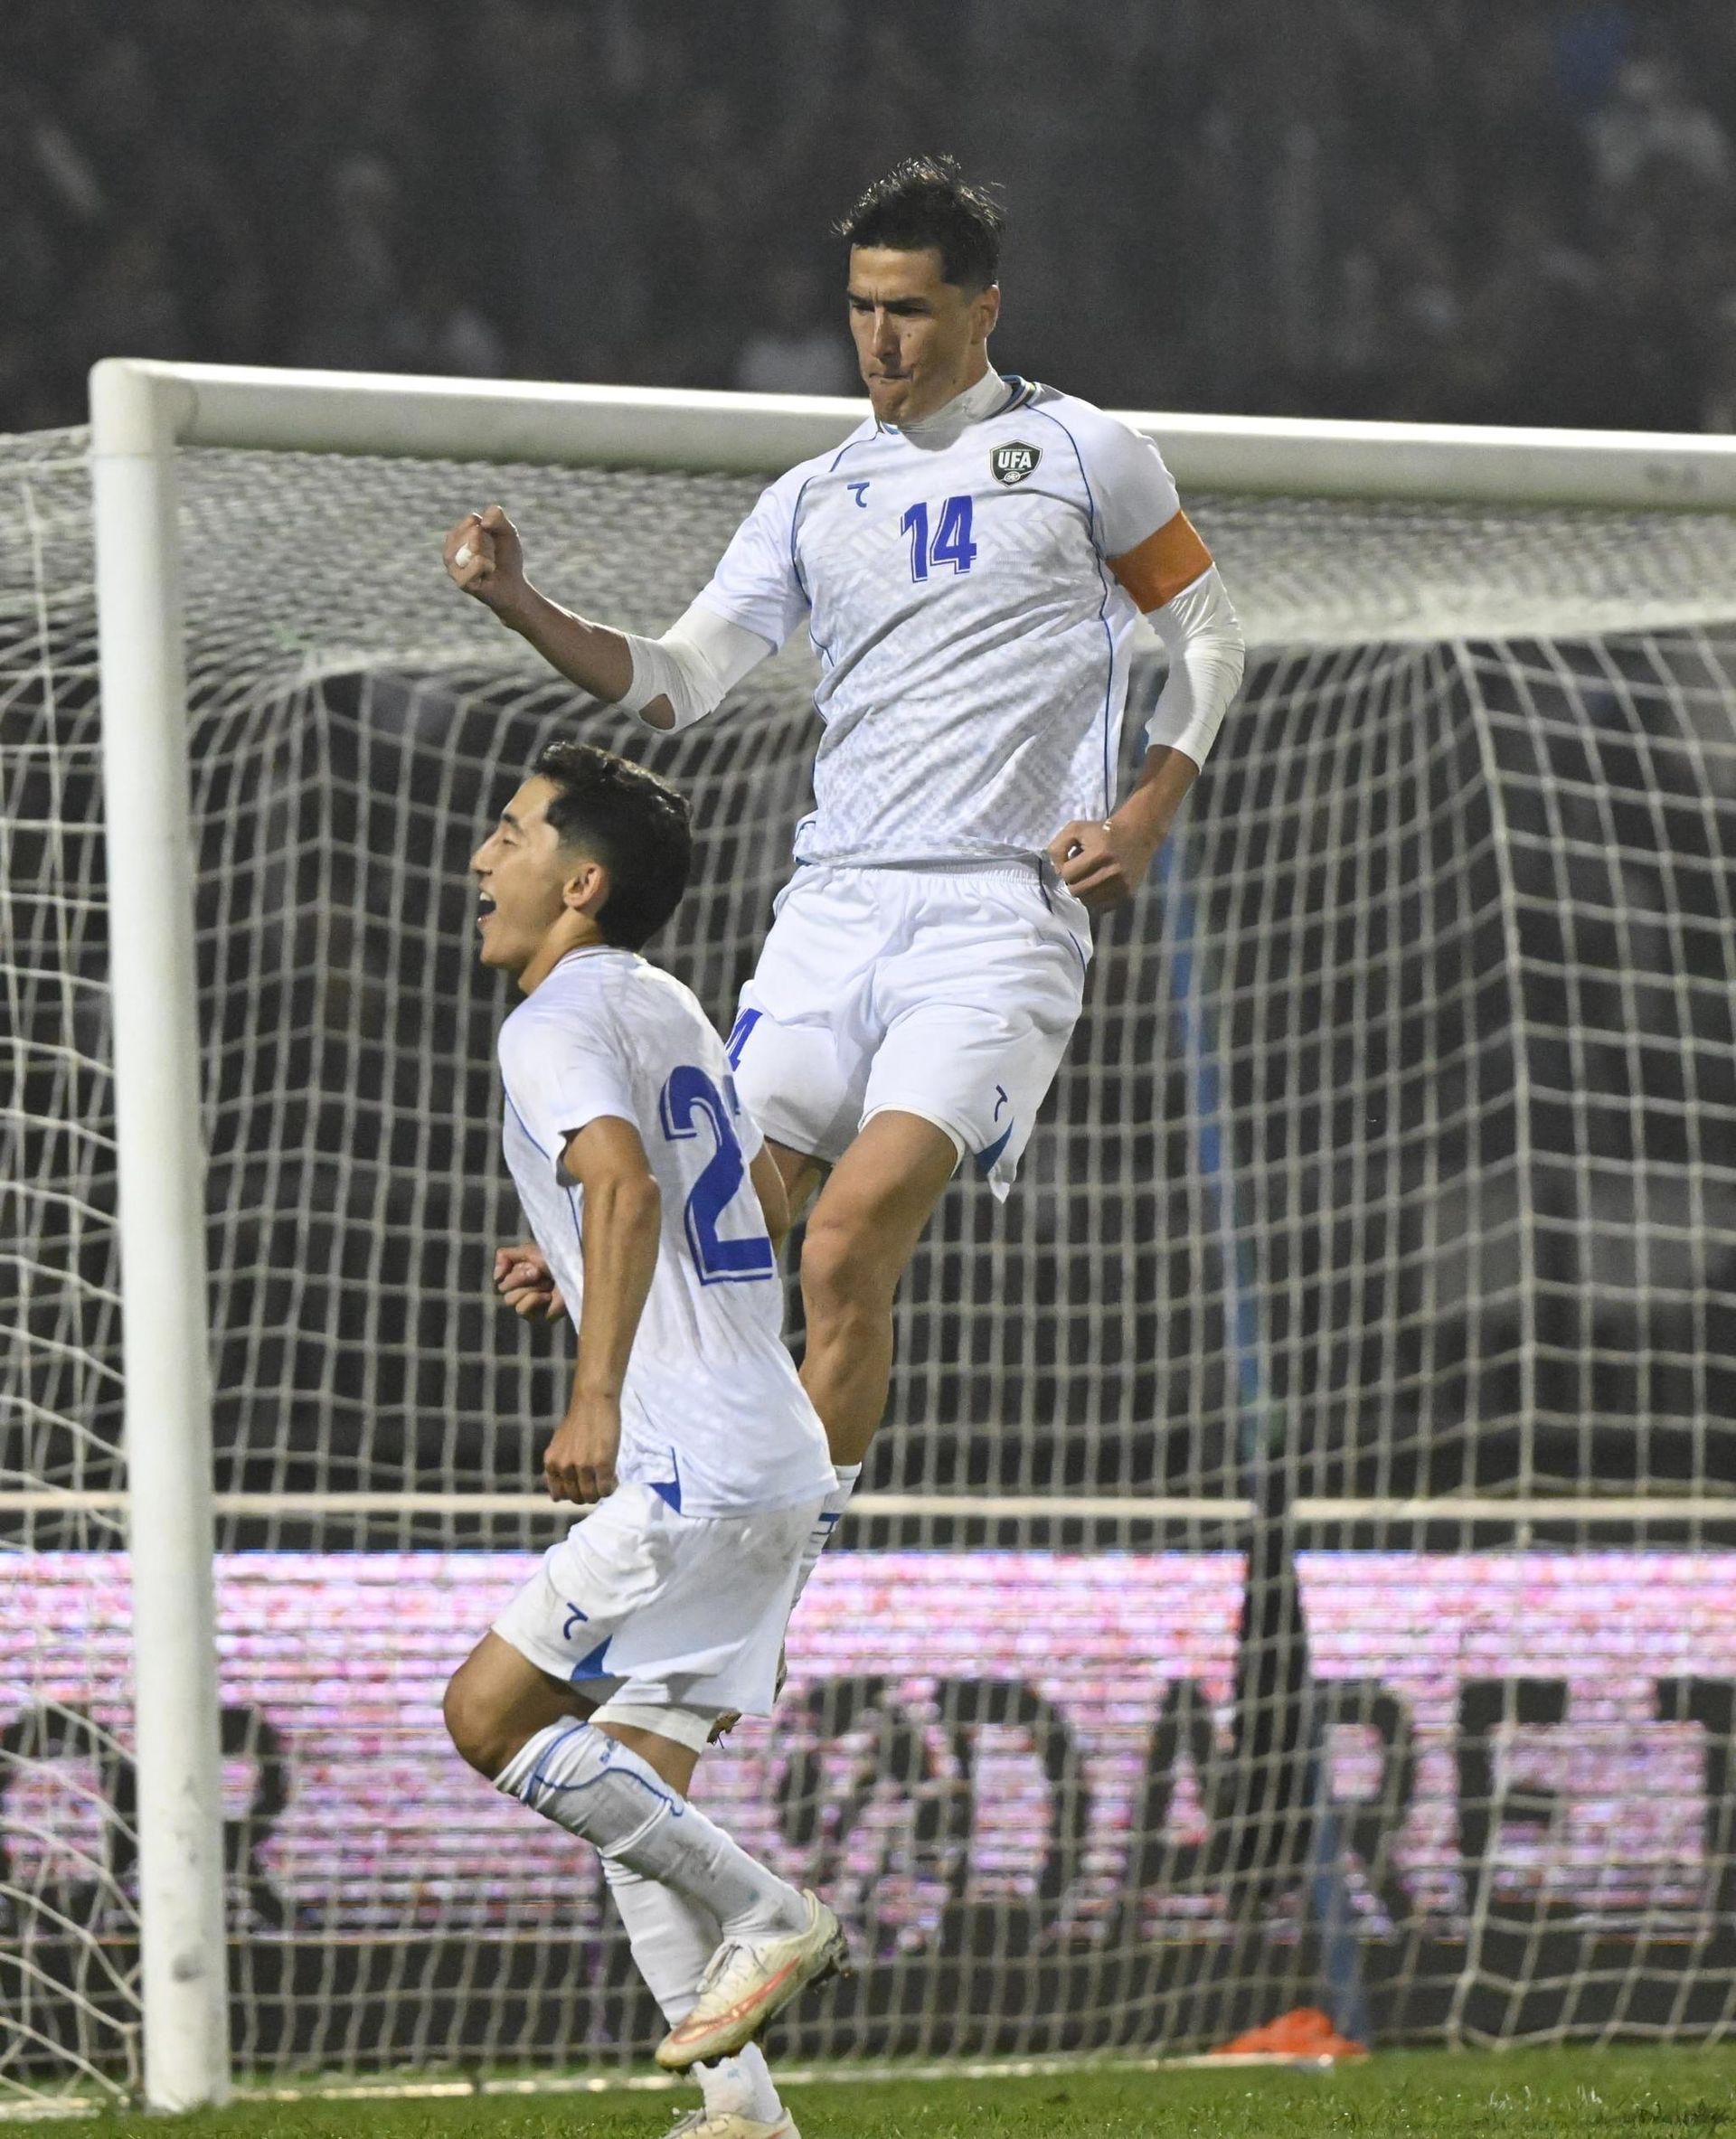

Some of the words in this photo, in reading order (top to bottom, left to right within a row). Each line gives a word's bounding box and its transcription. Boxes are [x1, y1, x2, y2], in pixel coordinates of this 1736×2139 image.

[997, 451, 1033, 468] UFA
[901, 495, 977, 583] 14
[659, 1065, 773, 1286] 2
